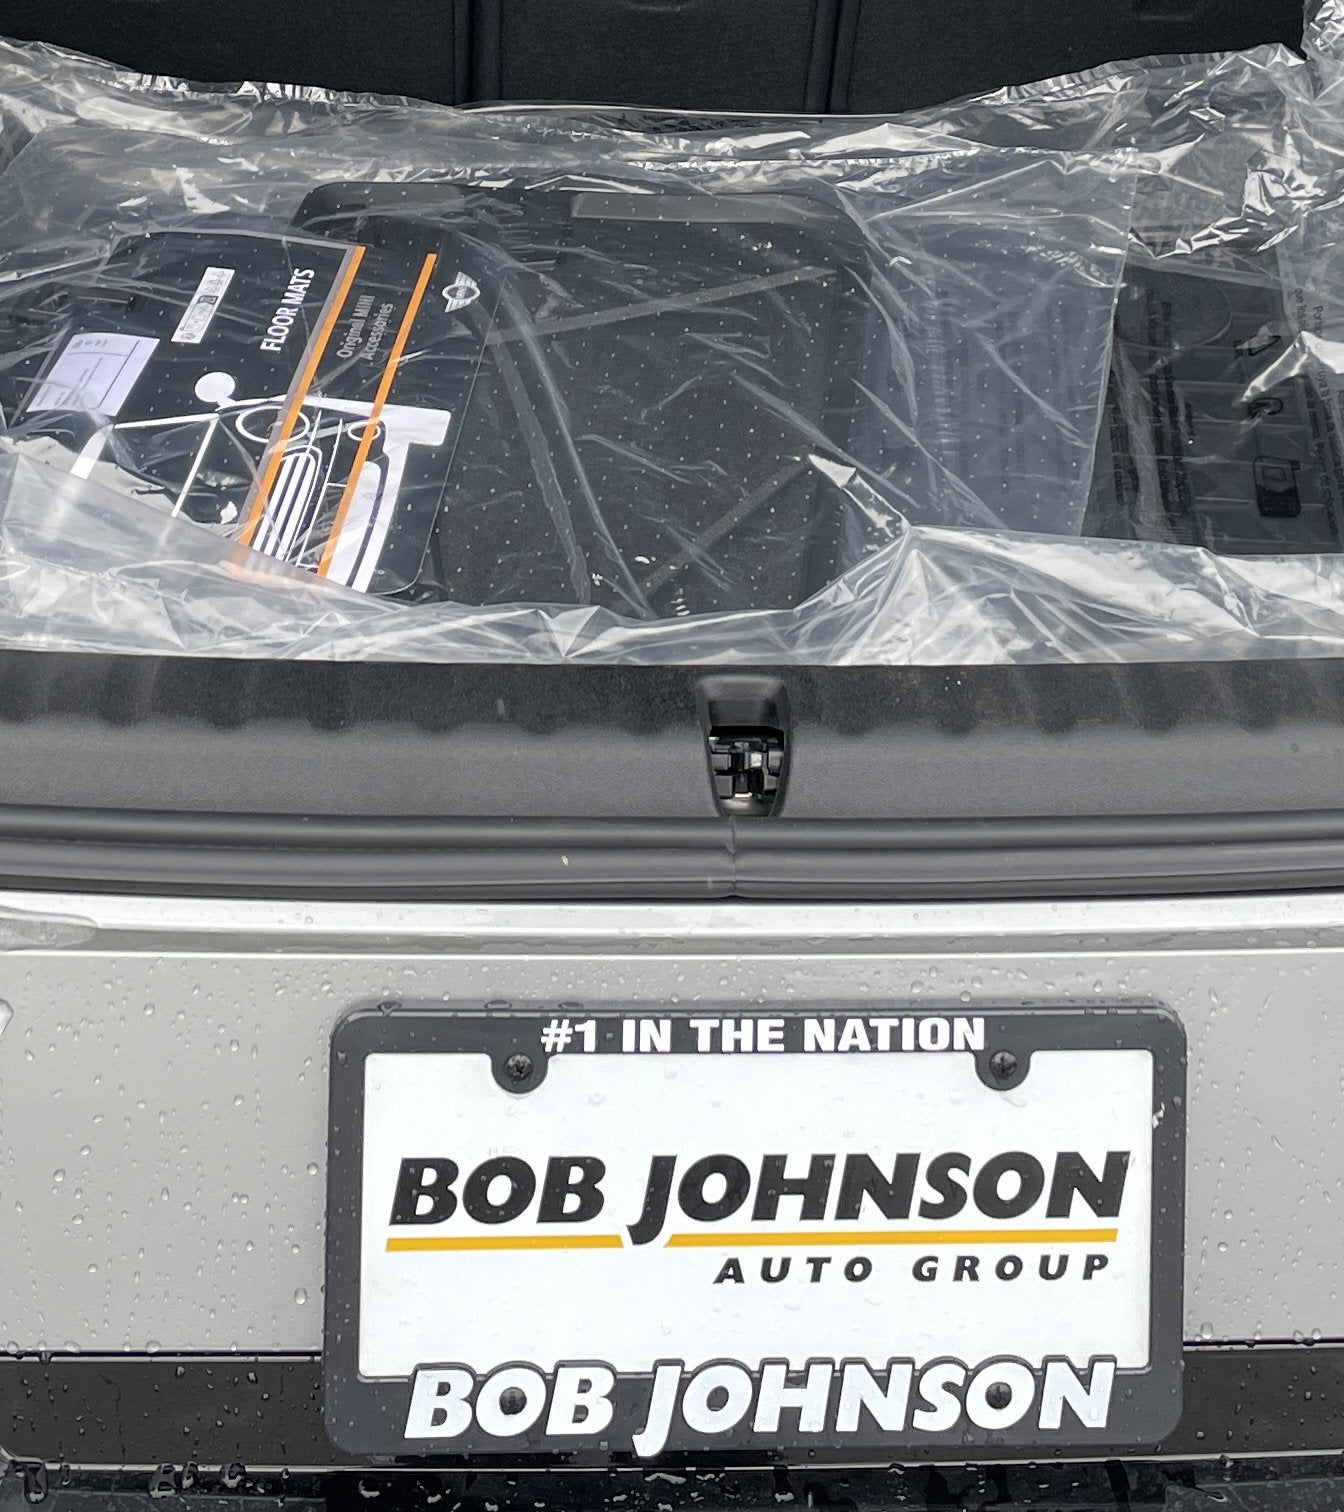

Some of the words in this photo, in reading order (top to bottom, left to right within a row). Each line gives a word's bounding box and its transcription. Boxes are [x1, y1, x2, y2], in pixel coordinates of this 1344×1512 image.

[260, 307, 299, 351] FLOOR
[281, 268, 315, 304] MATS
[337, 319, 365, 358] Original
[353, 295, 375, 317] MINI
[359, 303, 394, 360] Accessories
[541, 1019, 597, 1054] #1
[621, 1019, 671, 1053] IN
[689, 1018, 784, 1053] THE
[803, 1017, 985, 1052] NATION
[389, 1156, 606, 1225] BOB
[627, 1151, 1130, 1246] JOHNSON
[713, 1255, 874, 1285] AUTO
[912, 1253, 1110, 1282] GROUP
[404, 1361, 618, 1440] BOB
[632, 1357, 1116, 1457] JOHNSON
